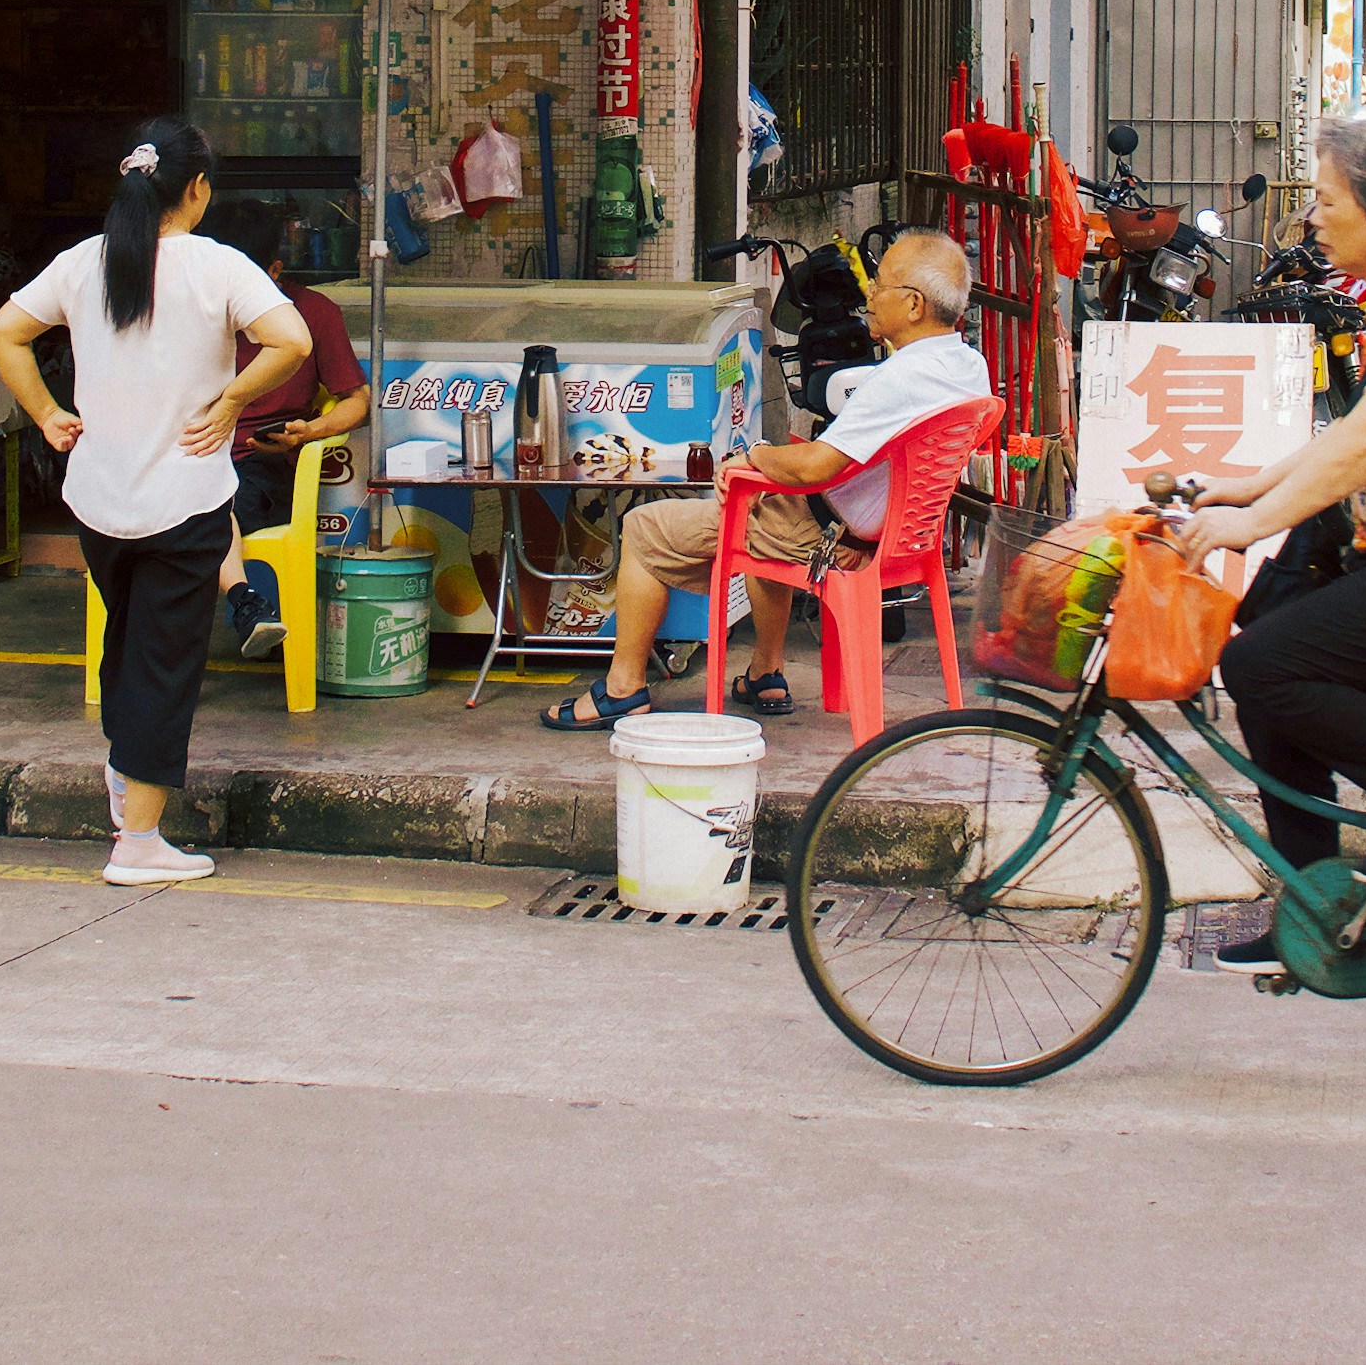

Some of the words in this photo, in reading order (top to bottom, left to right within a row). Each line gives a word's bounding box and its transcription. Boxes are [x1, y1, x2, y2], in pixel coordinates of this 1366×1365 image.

[1089, 326, 1119, 406] 打印
[381, 377, 508, 412] 自然纯真
[317, 518, 341, 530] 56
